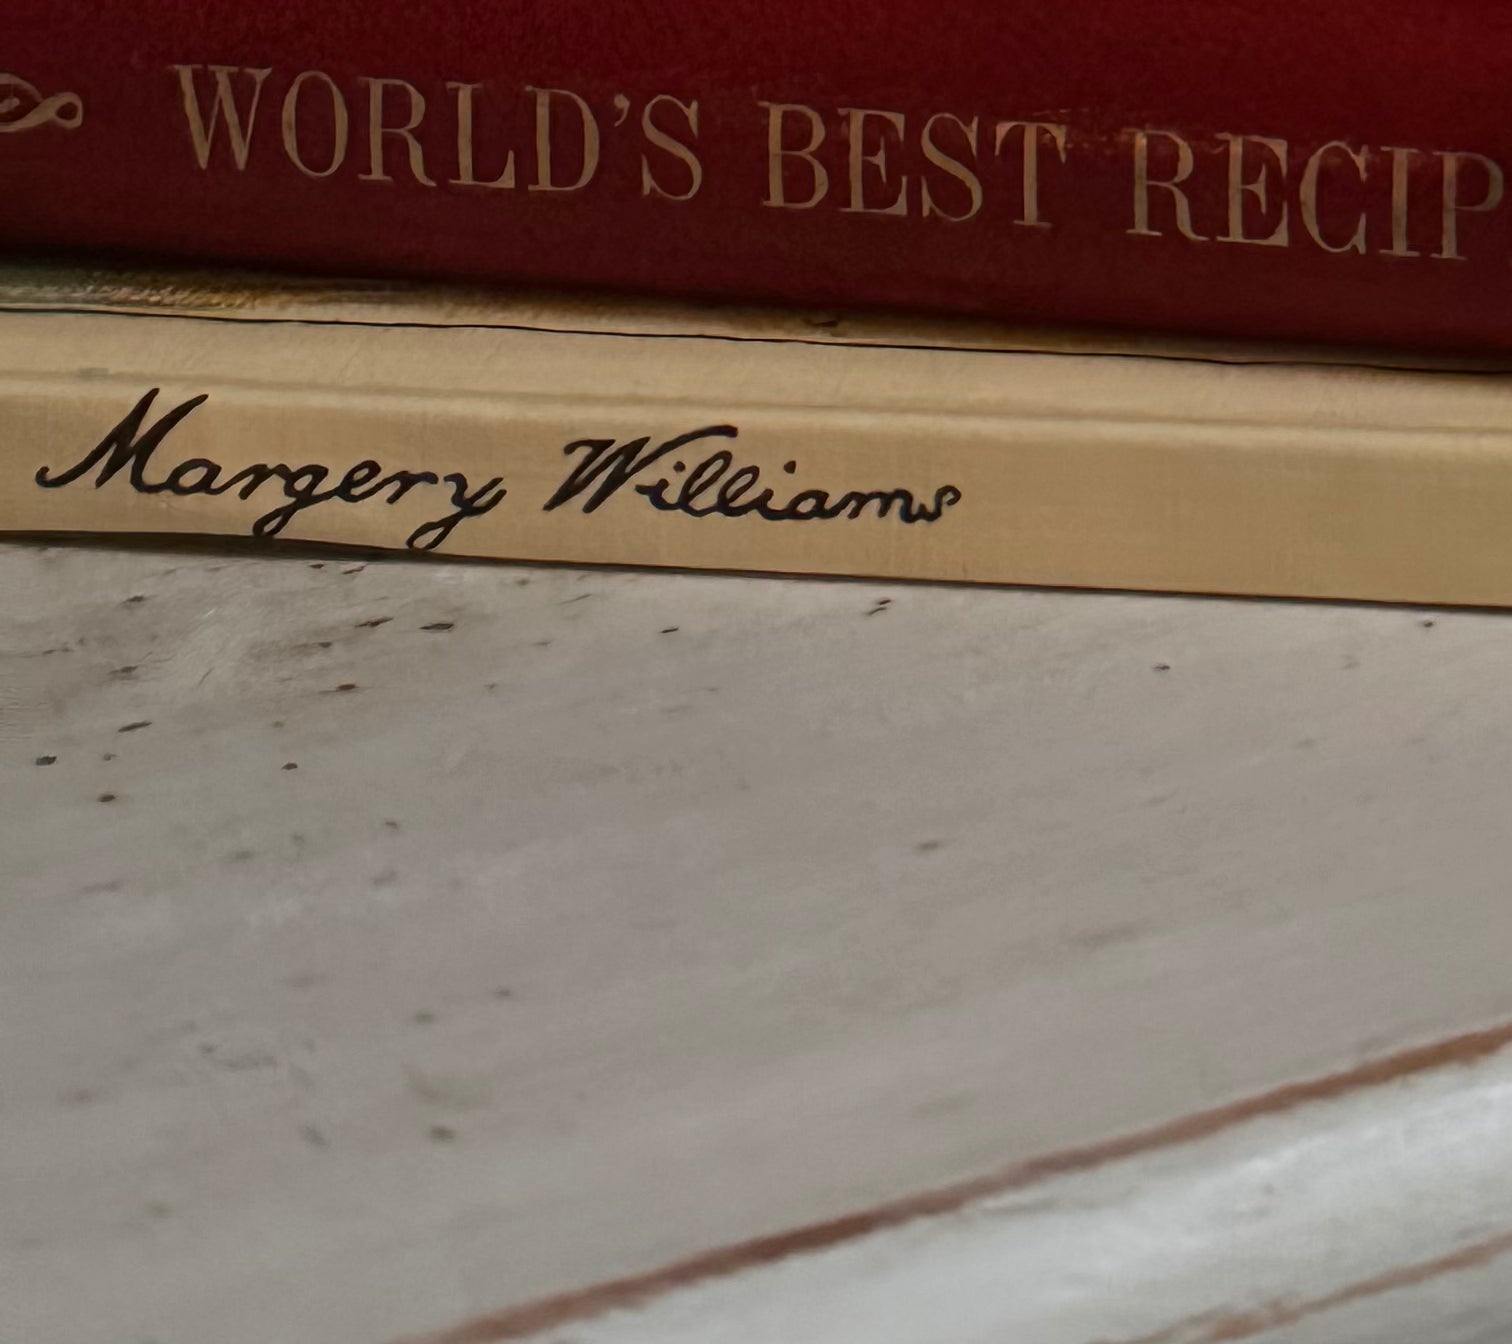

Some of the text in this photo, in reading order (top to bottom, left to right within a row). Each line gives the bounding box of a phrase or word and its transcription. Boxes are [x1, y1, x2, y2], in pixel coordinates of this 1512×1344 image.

[170, 63, 703, 201] WORLD'S
[759, 100, 1067, 229] BEST
[36, 387, 961, 551] Margery Williams
